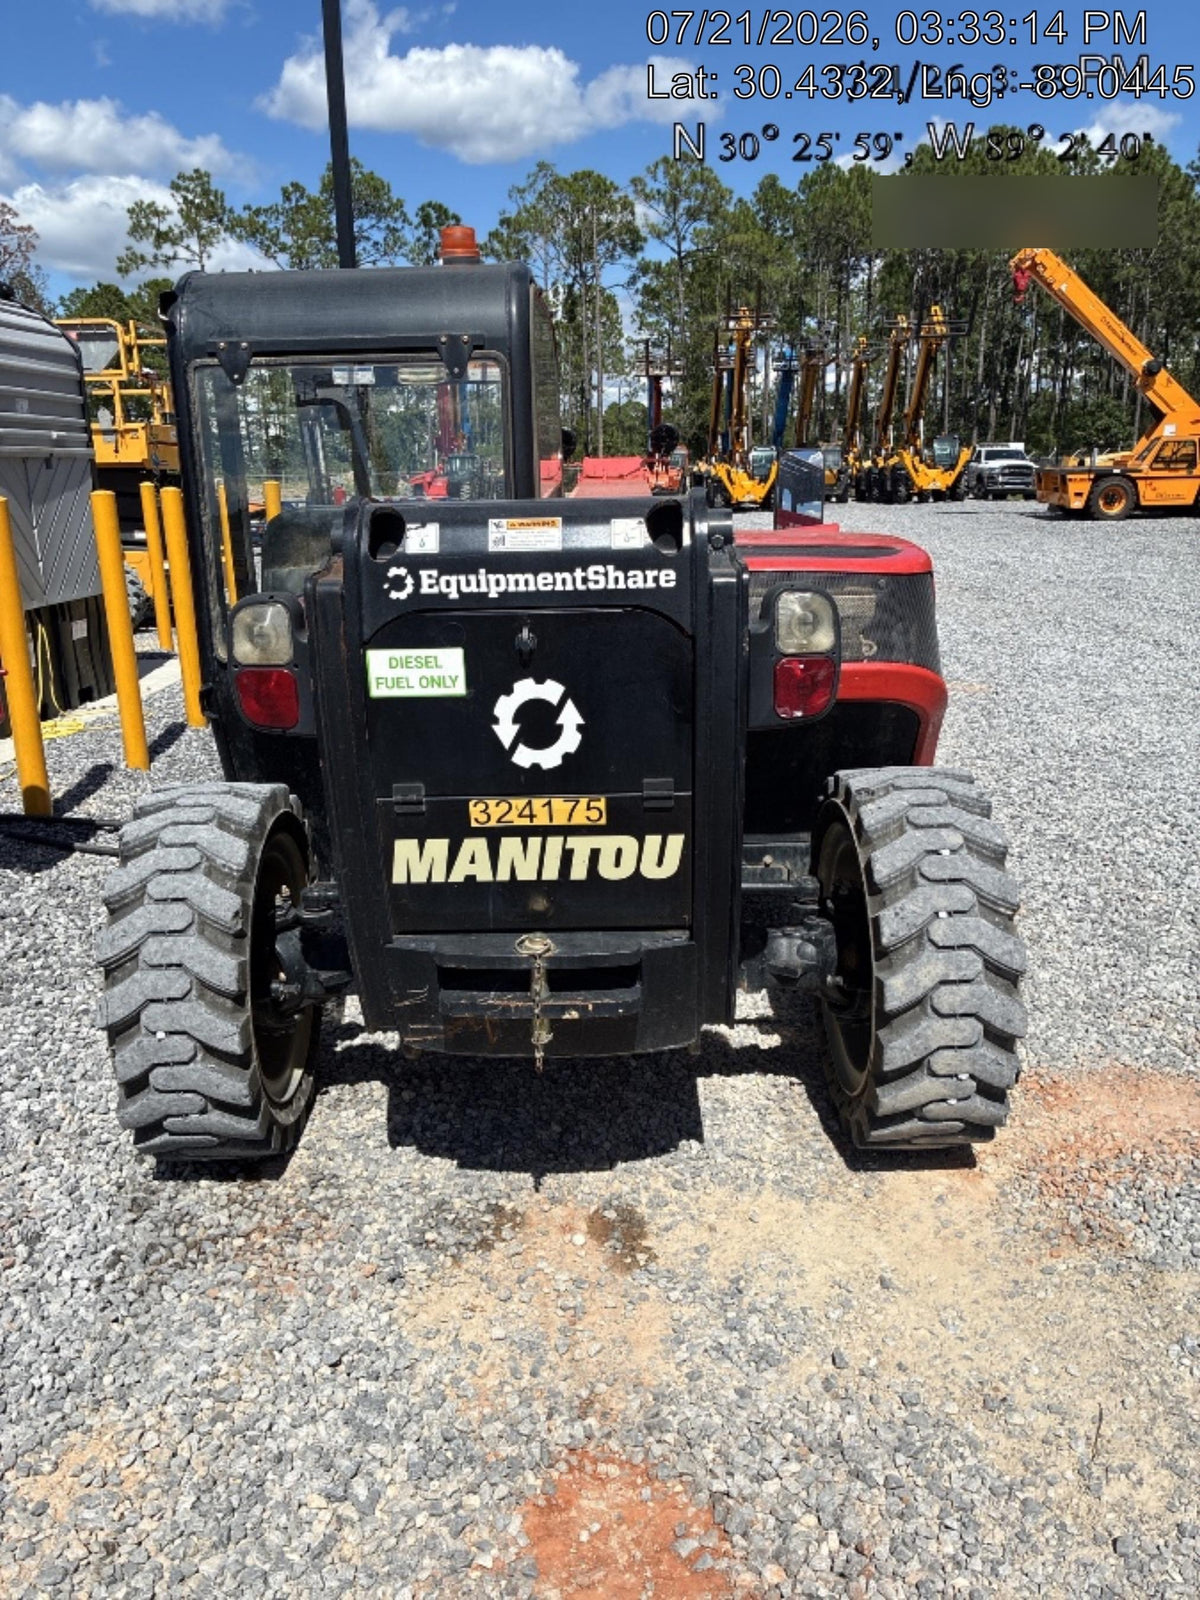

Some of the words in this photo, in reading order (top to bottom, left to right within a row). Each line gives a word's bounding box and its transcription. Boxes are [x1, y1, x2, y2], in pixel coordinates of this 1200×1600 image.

[418, 564, 677, 599] EquipmentShare
[388, 655, 444, 669] DIESEL
[375, 676, 415, 690] FUEL
[418, 675, 459, 689] ONLY
[473, 798, 604, 826] 324175
[391, 833, 686, 884] MANITOU
